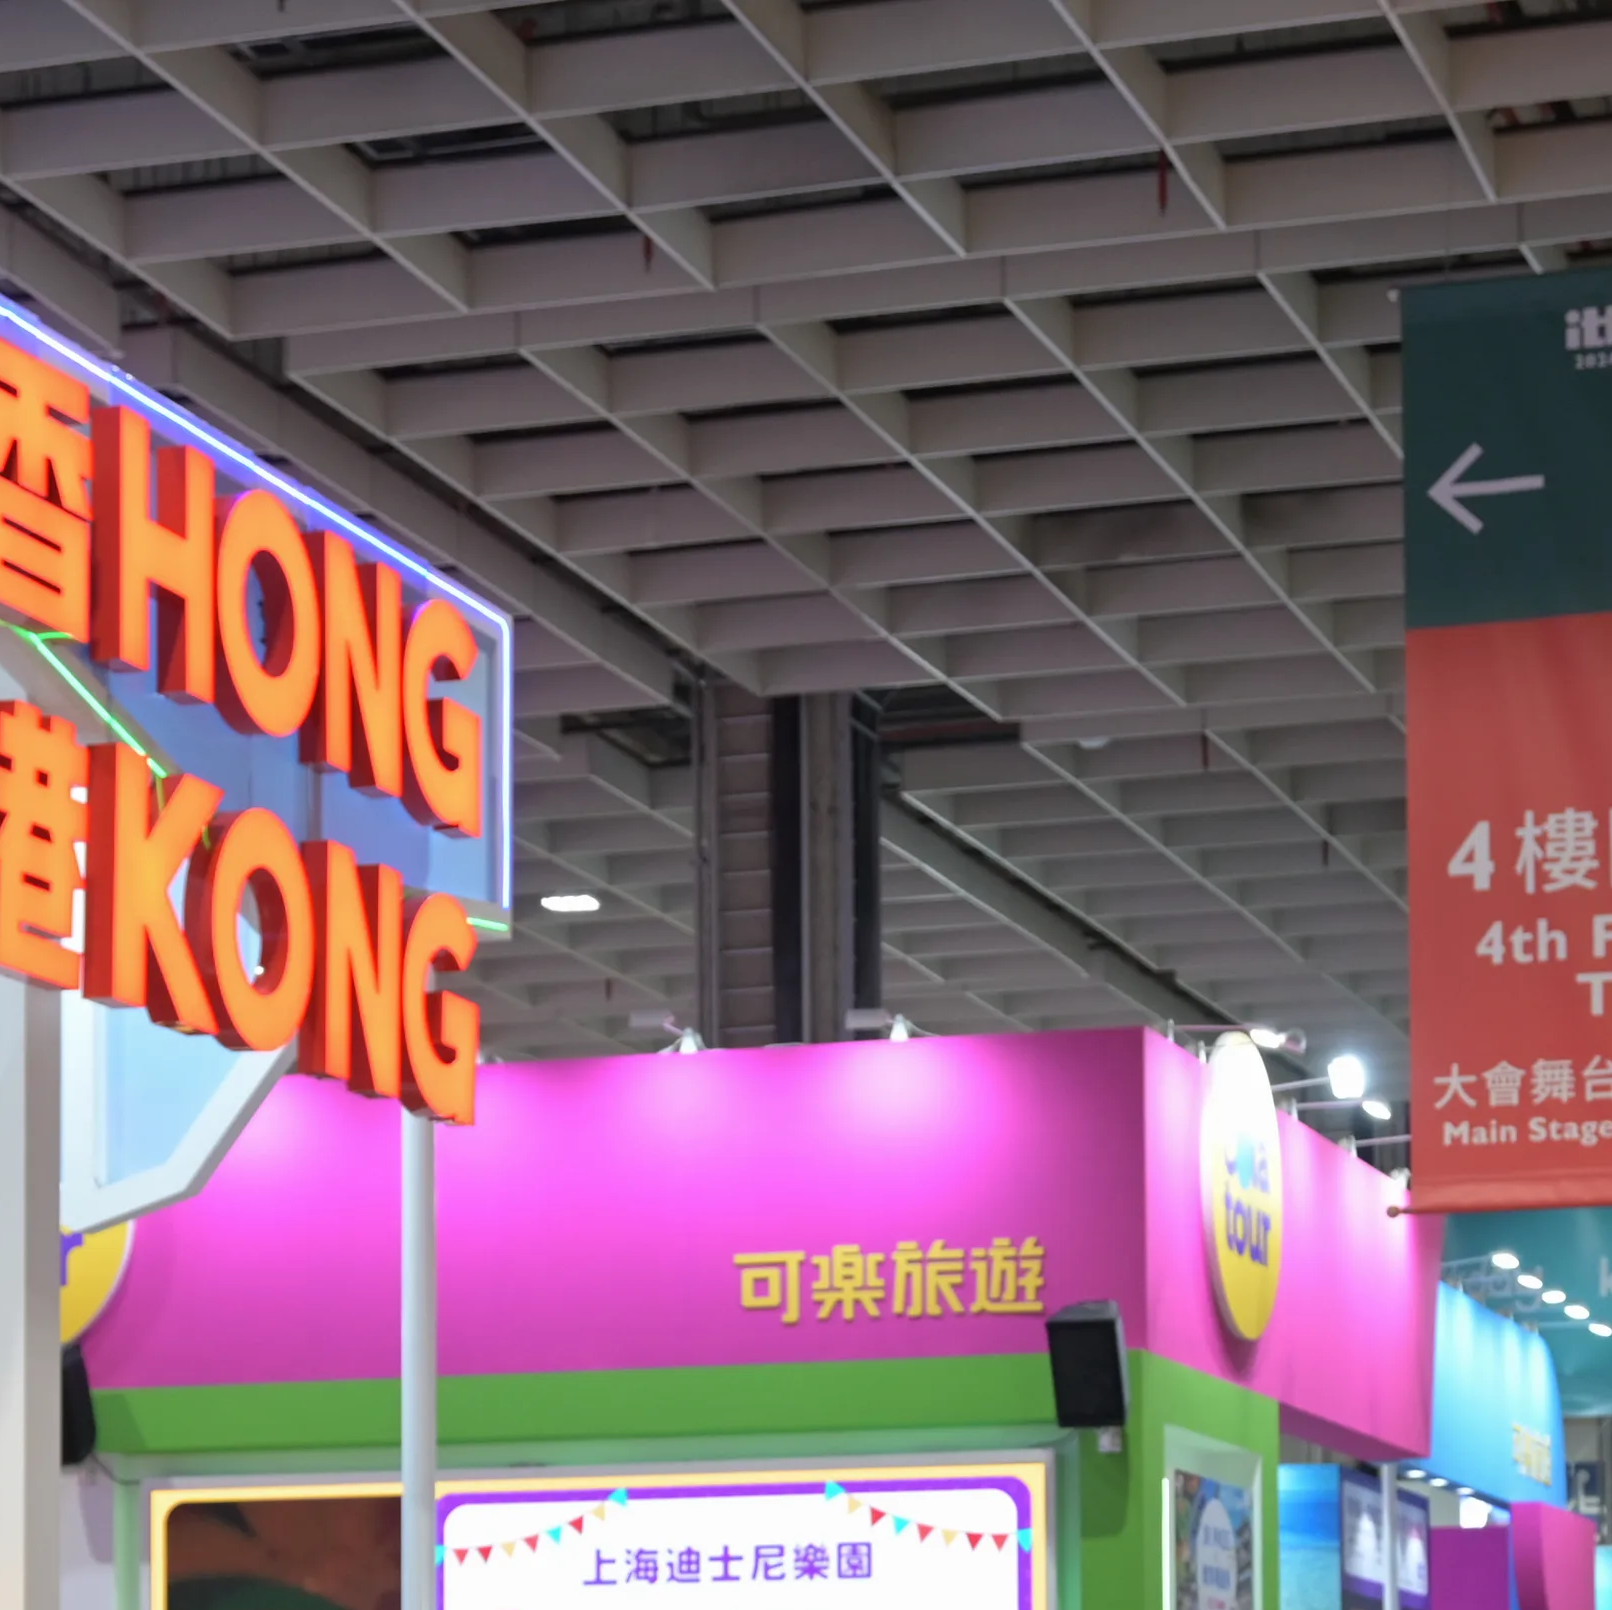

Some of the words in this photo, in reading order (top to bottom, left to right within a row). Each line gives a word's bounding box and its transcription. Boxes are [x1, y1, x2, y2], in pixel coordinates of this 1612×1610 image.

[91, 405, 482, 839] HONG
[83, 740, 480, 1126] KONG
[1476, 917, 1568, 966] 4th
[1443, 1120, 1517, 1146] Main
[583, 1542, 873, 1586] 上海迪士尼樂園
